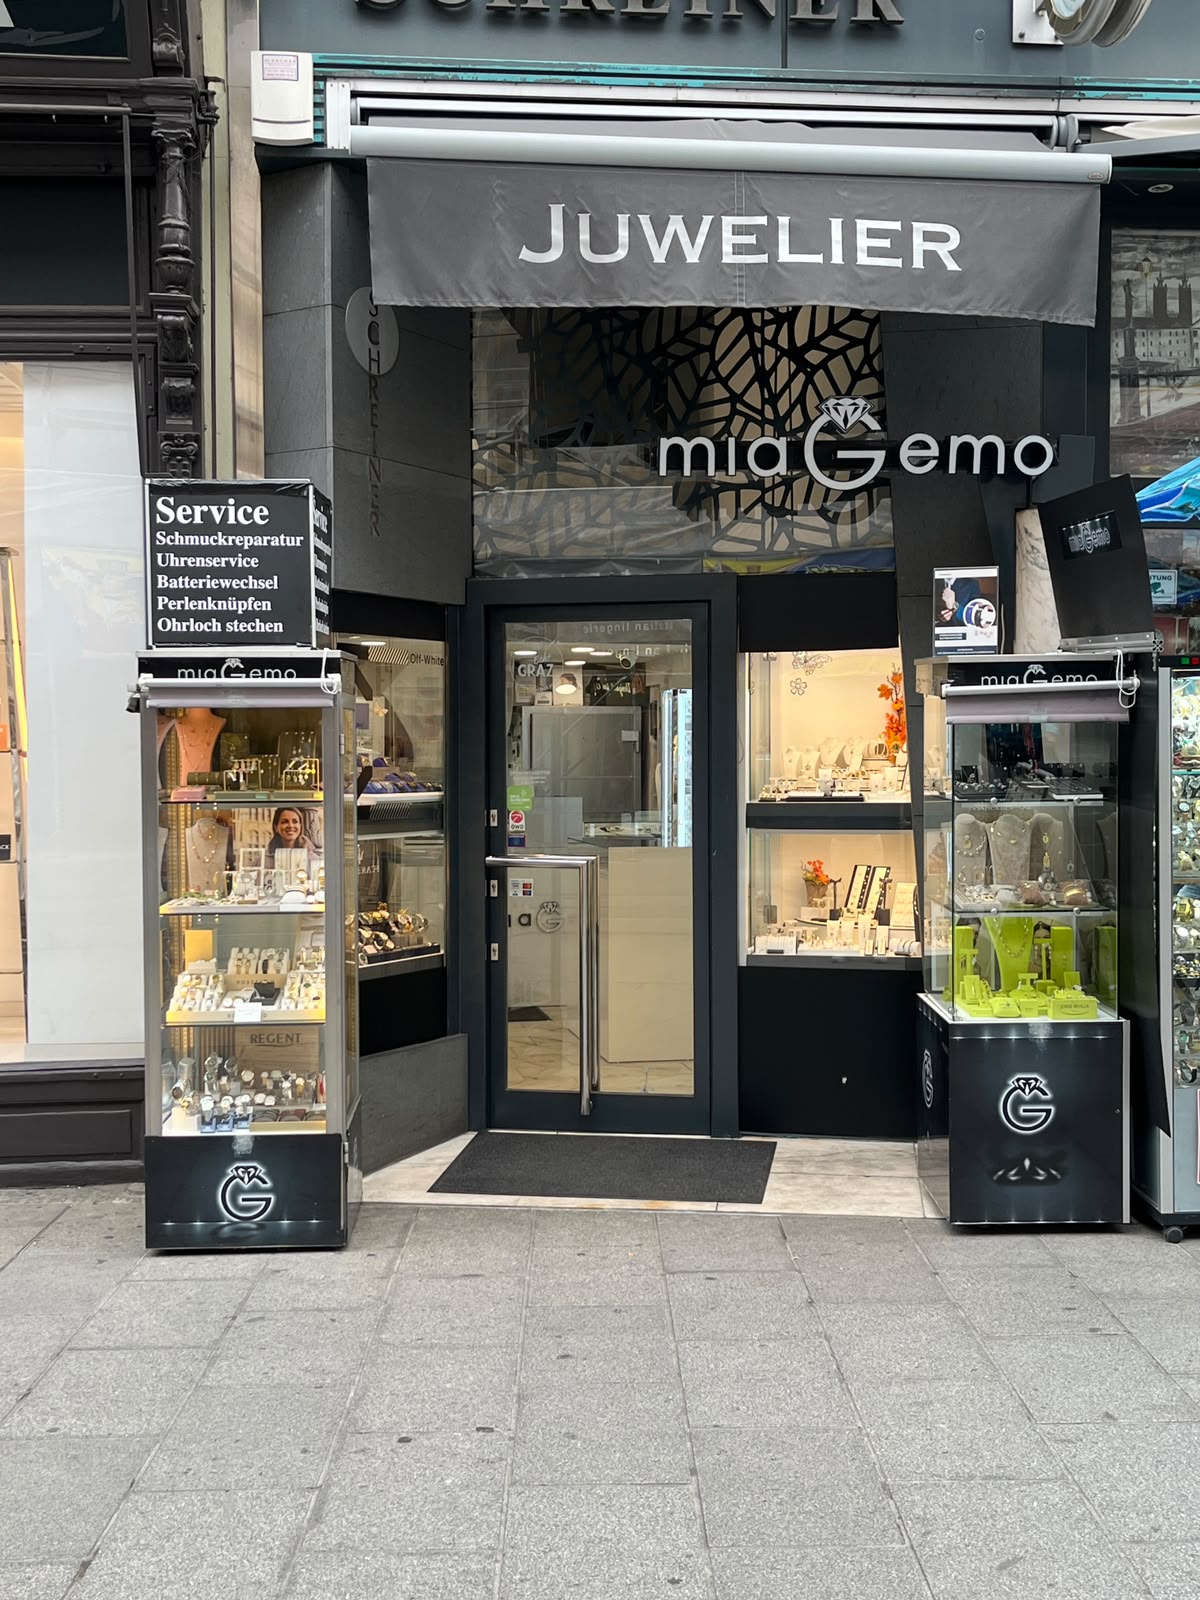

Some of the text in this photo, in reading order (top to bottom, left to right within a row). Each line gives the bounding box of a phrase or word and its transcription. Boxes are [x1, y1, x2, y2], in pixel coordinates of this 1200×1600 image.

[518, 203, 962, 271] JUWELIER
[658, 395, 1054, 491] miaGemo
[156, 496, 270, 525] Service
[156, 530, 304, 550] Schmuckreparatur
[157, 553, 260, 568] Uhrenservice
[157, 574, 279, 590] Batteriewechsel
[157, 596, 272, 614] Perlenknüpfen
[157, 617, 284, 633] Ohrloch stechen
[410, 653, 445, 666] Off-White
[517, 663, 554, 677] GRAZ
[250, 1032, 302, 1044] REGENT
